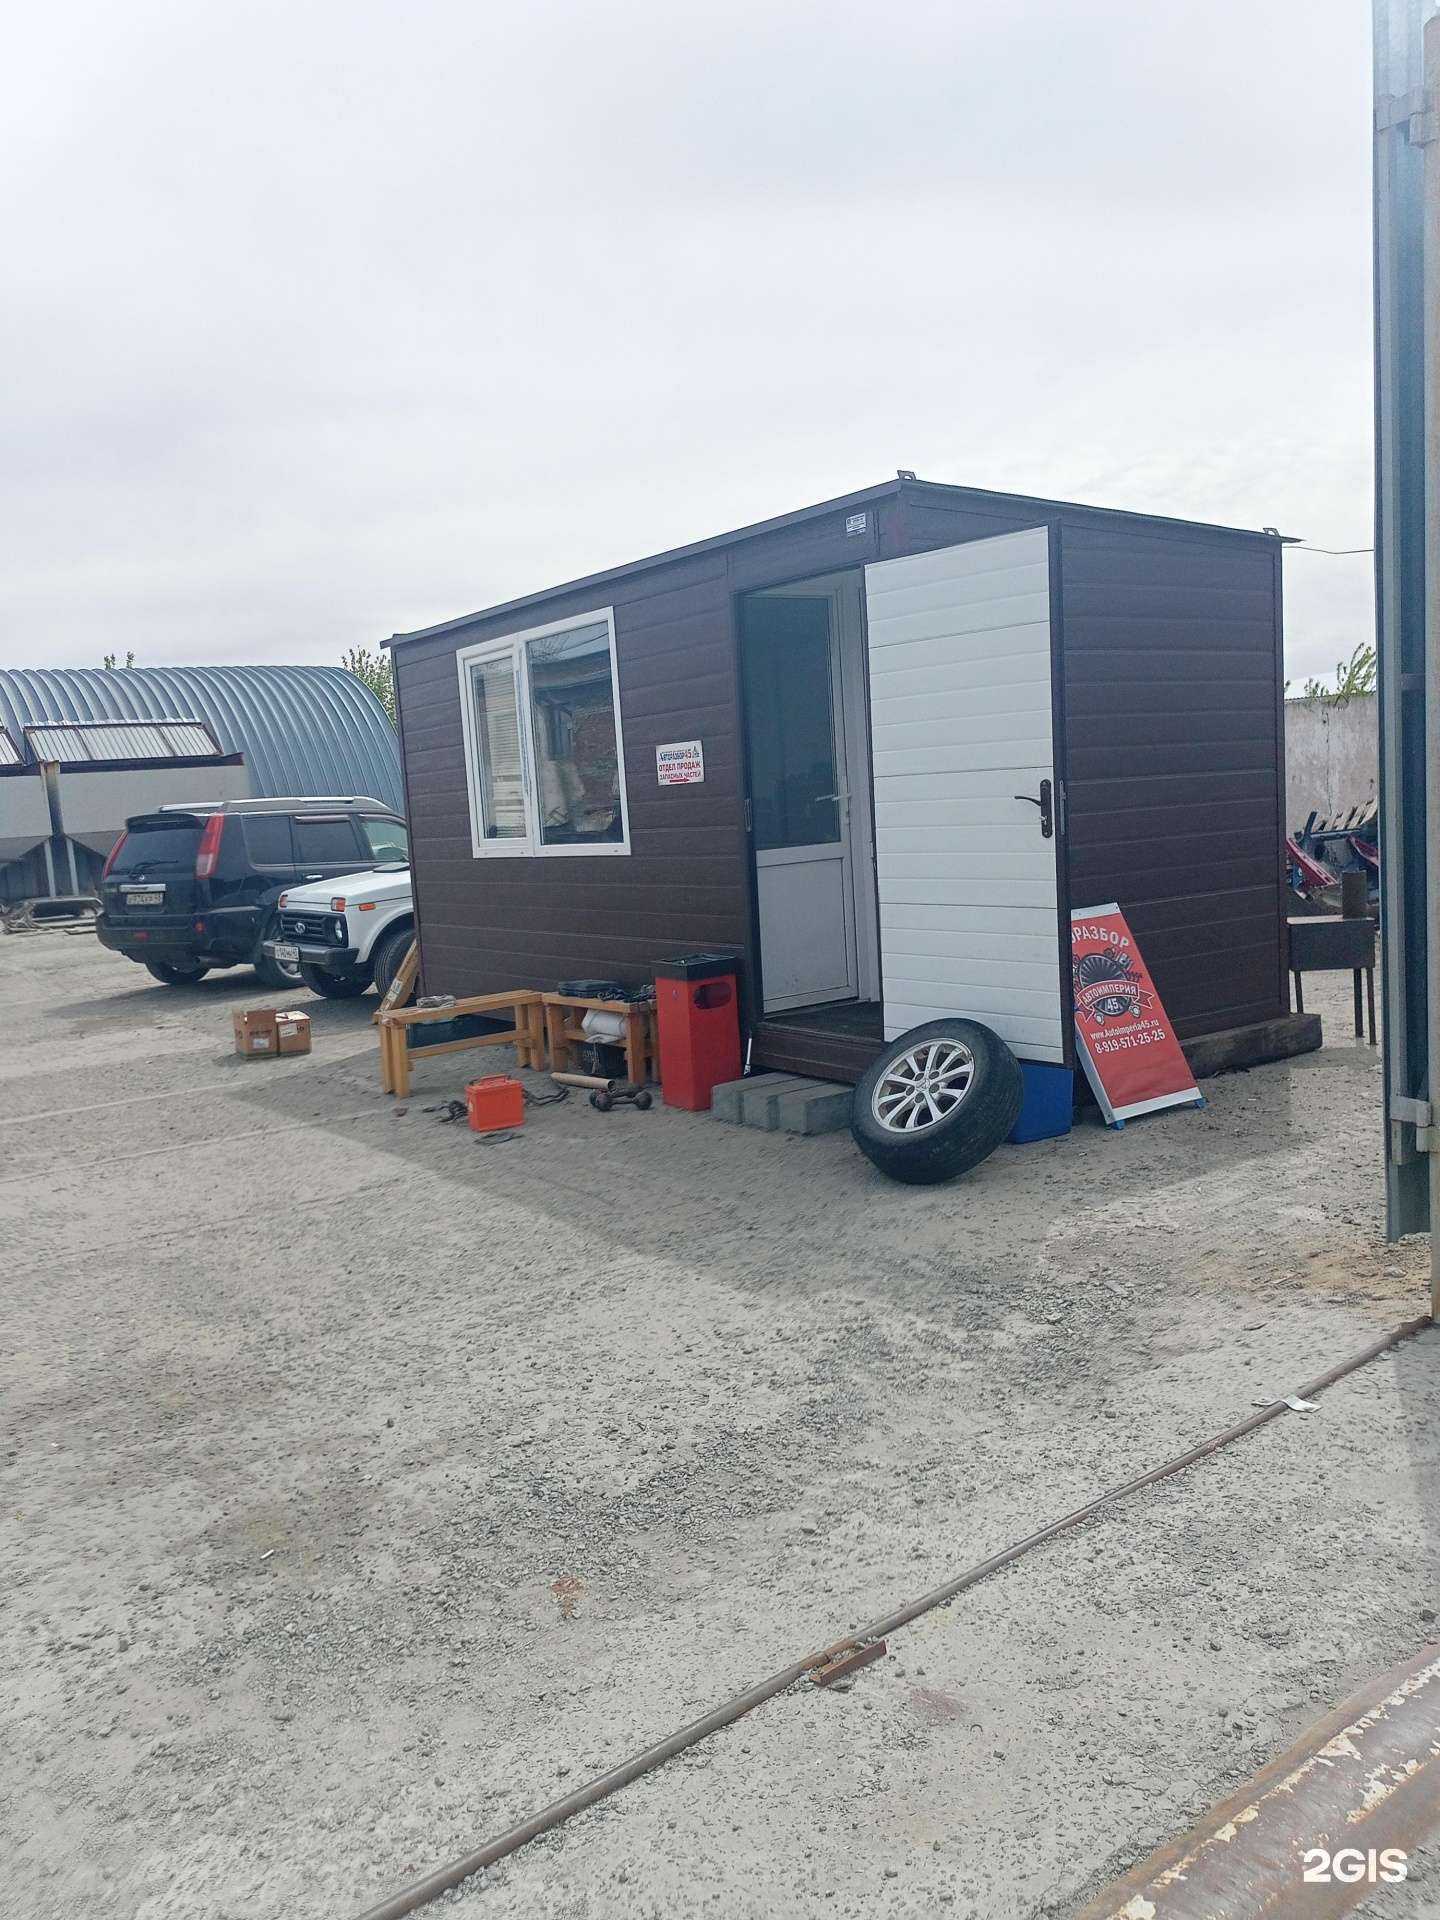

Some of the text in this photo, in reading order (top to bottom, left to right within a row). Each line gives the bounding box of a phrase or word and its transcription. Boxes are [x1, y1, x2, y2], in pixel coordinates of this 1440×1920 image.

[659, 760, 701, 773] ОТДЕЛ ПРОДАЖ
[684, 770, 701, 778] ЧАСТЕЙ
[1082, 984, 1136, 1005] АВТОИМПЕРИЯ
[1107, 998, 1119, 1010] 45
[1095, 1029, 1166, 1054] 8-919-571-25-25
